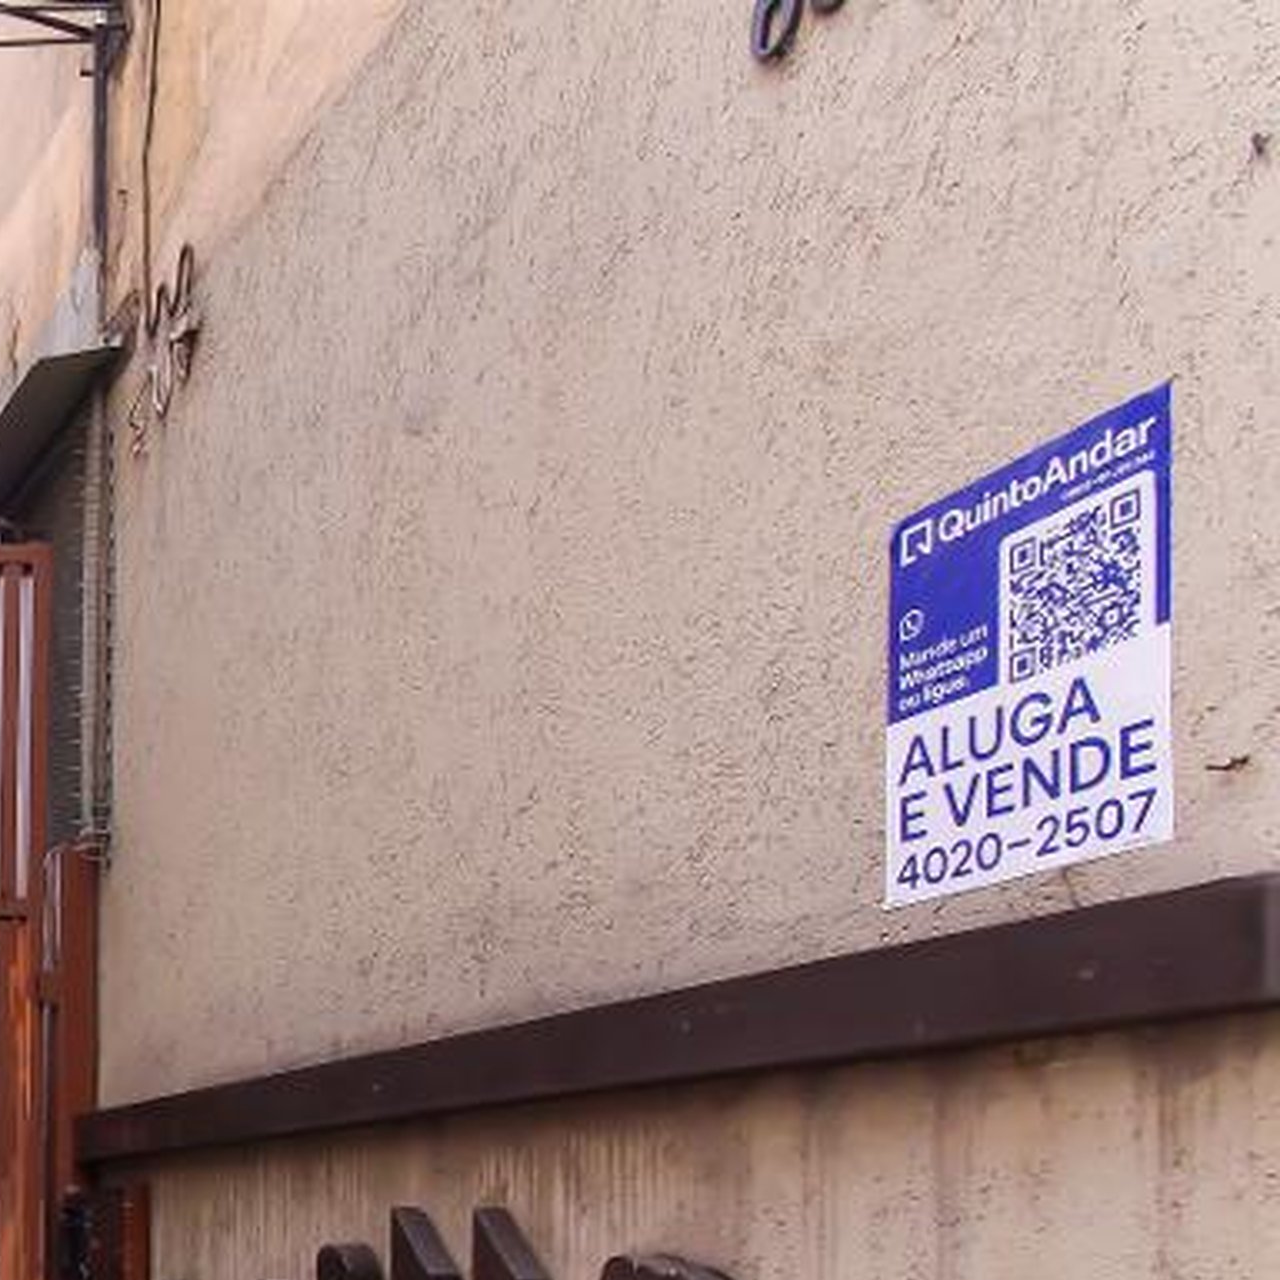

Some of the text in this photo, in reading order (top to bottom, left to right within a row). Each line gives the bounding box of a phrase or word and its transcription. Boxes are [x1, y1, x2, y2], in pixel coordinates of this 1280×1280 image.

[938, 416, 1155, 542] QuintoAndar
[899, 677, 1101, 787] ALUGA
[900, 717, 1157, 842] E VENDE
[896, 788, 1157, 889] 4020-2507
